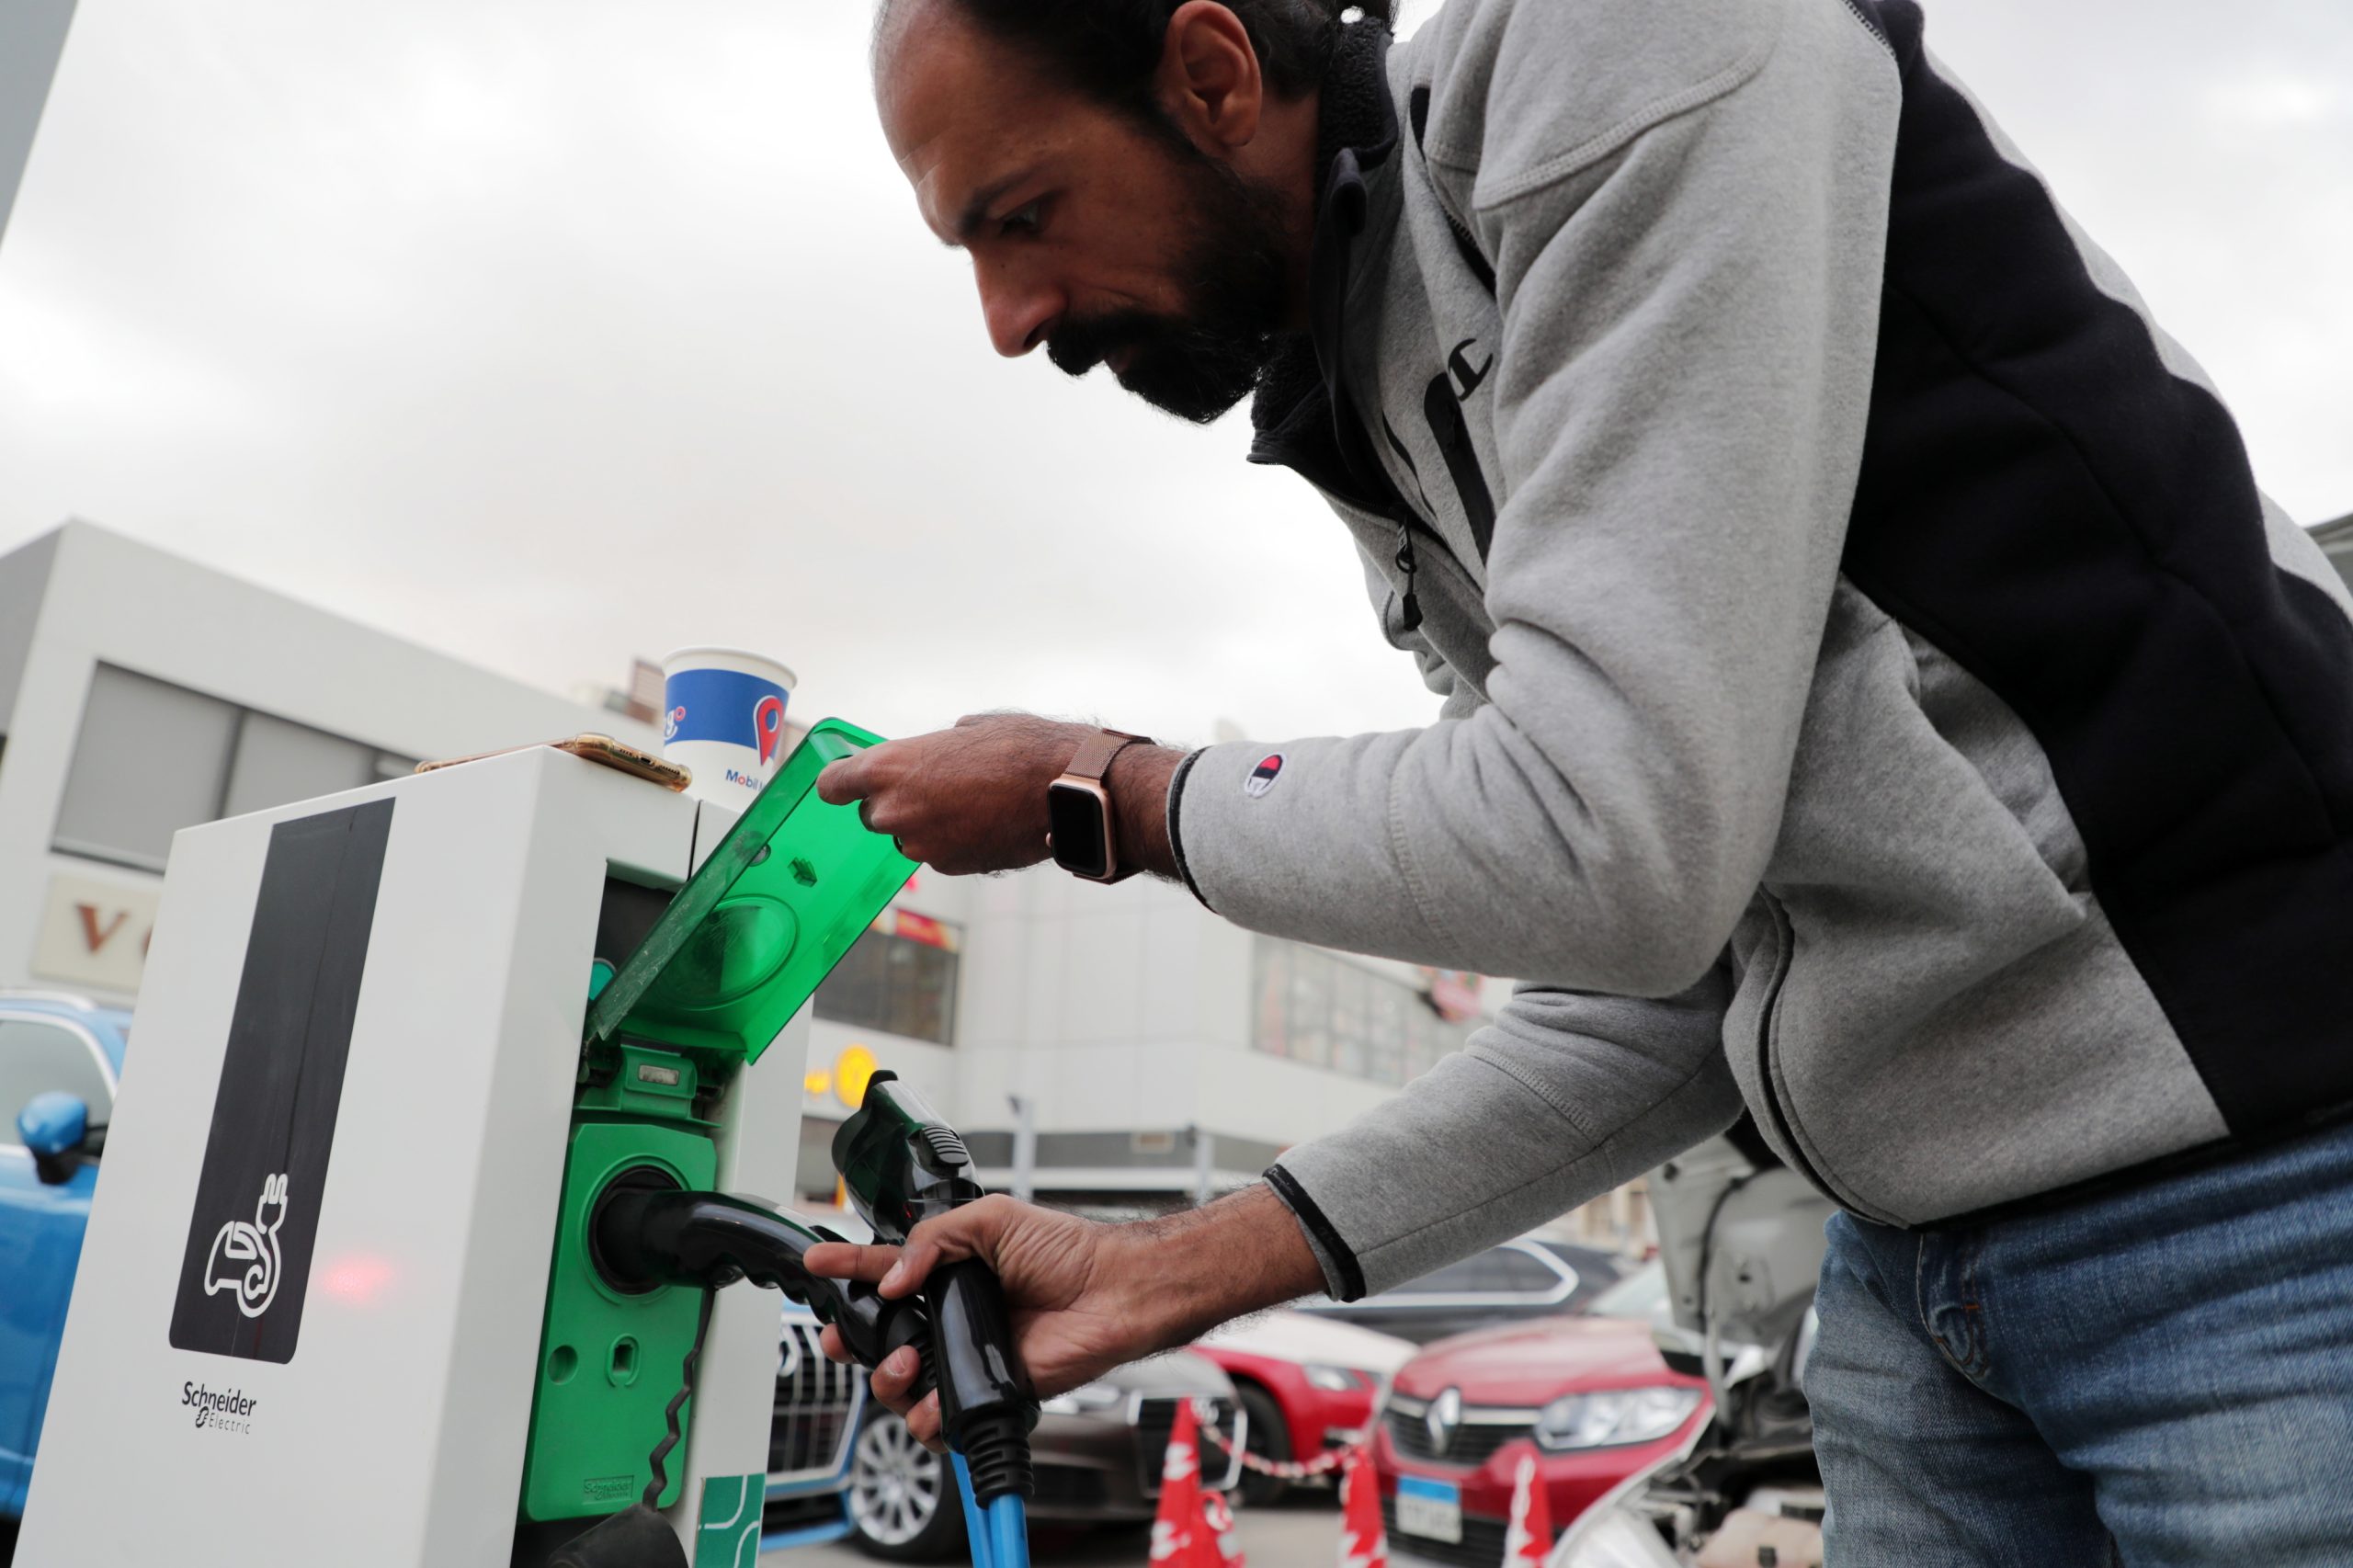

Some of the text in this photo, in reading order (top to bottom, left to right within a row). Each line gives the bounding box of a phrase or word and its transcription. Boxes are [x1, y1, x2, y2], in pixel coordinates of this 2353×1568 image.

[725, 769, 758, 790] Mobil
[182, 1381, 256, 1416] Schneider
[209, 1412, 250, 1434] Electric
